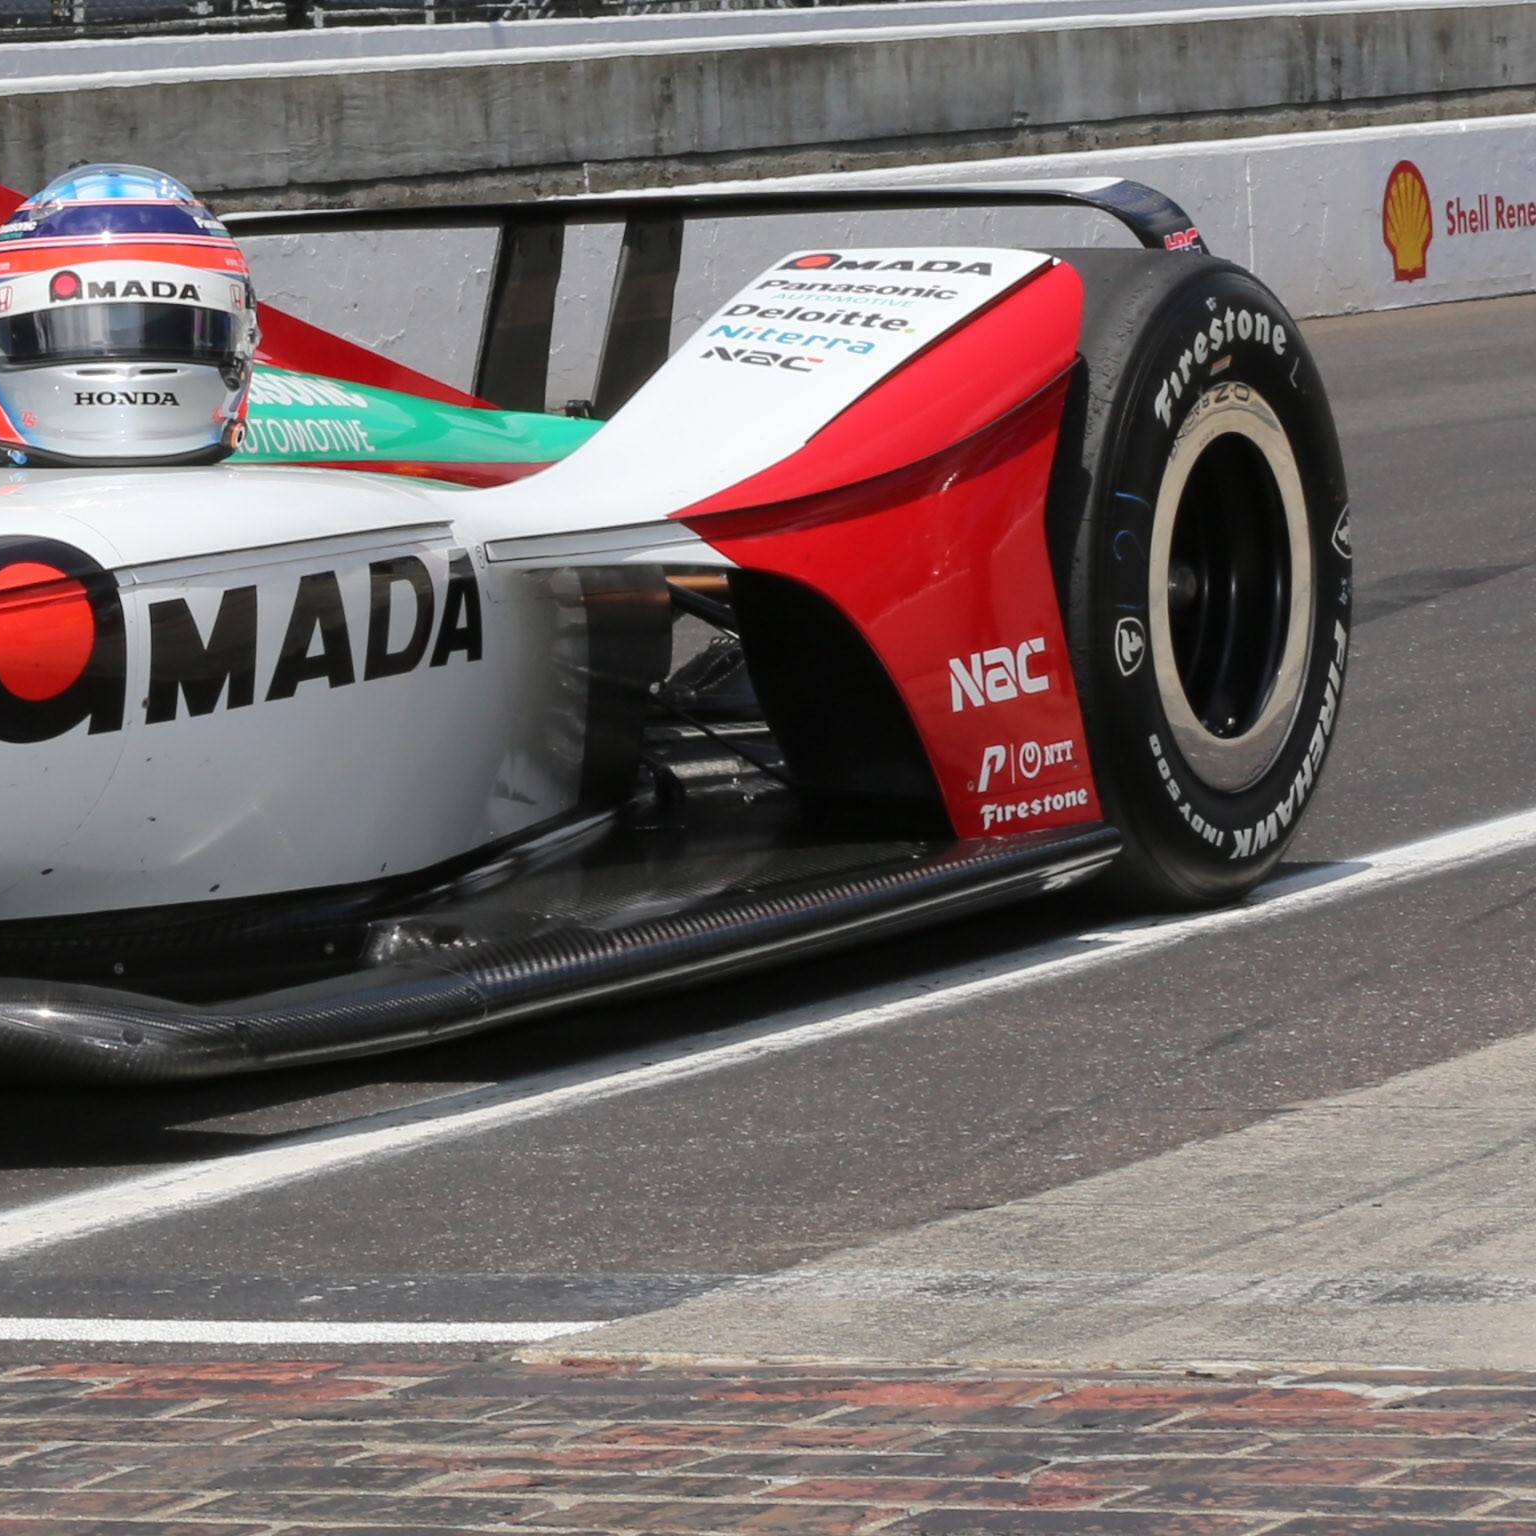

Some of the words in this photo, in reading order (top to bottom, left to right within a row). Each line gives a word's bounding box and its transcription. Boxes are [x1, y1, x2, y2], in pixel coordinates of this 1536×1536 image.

[1446, 194, 1490, 236] Shell
[778, 253, 993, 277] AMADA
[49, 270, 202, 303] AMADA
[755, 279, 959, 301] Panasonic
[772, 292, 916, 309] AUTOMOTIVE
[706, 323, 877, 355] Niterra
[699, 345, 824, 373] NEC
[1154, 305, 1288, 429] Firestone
[74, 391, 180, 407] HONDA
[948, 637, 1050, 713] NEC
[1043, 740, 1074, 767] NTT
[1228, 619, 1348, 860] FIREHAWK
[1148, 733, 1181, 802] 500
[980, 787, 1089, 831] Firestone
[1178, 802, 1225, 847] INDY
